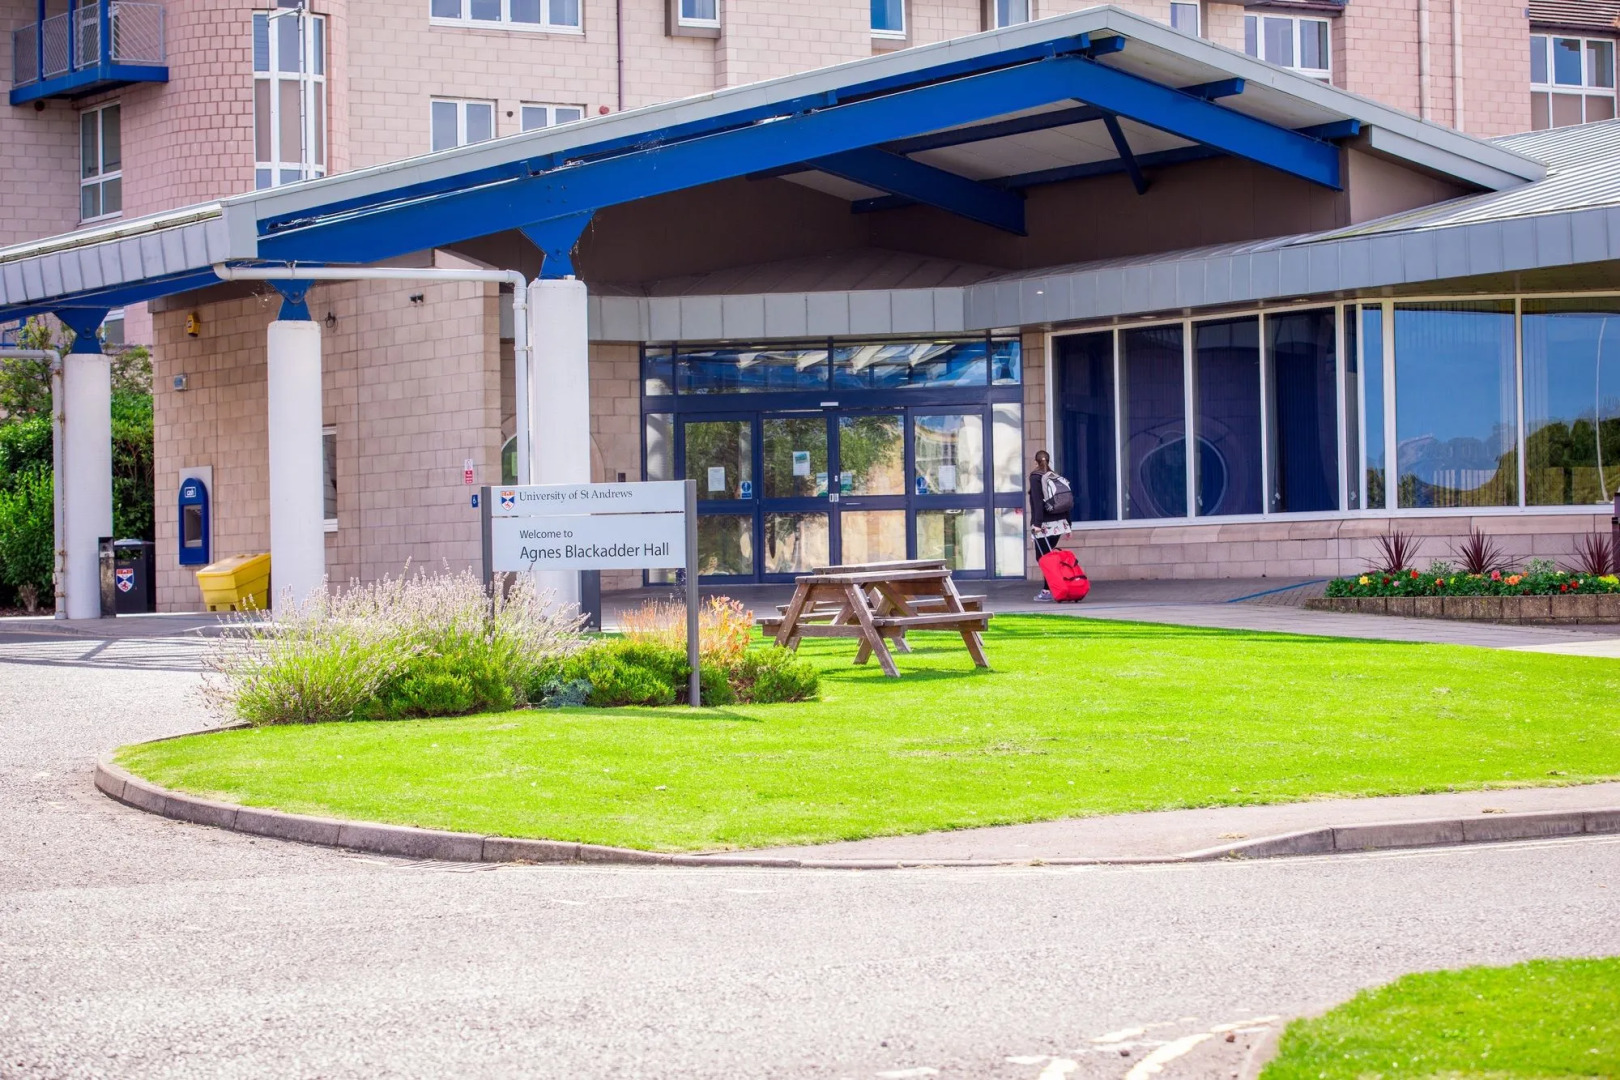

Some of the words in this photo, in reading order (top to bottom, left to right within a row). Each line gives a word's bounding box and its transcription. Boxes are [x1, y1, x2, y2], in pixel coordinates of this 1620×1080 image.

[519, 491, 566, 503] University
[568, 489, 578, 500] of
[580, 490, 589, 500] St
[591, 489, 633, 500] Andrews
[519, 530, 561, 539] Welcome
[563, 530, 573, 538] to
[520, 546, 561, 562] Agnes
[565, 543, 640, 558] Blackadder
[644, 542, 669, 556] Hall
